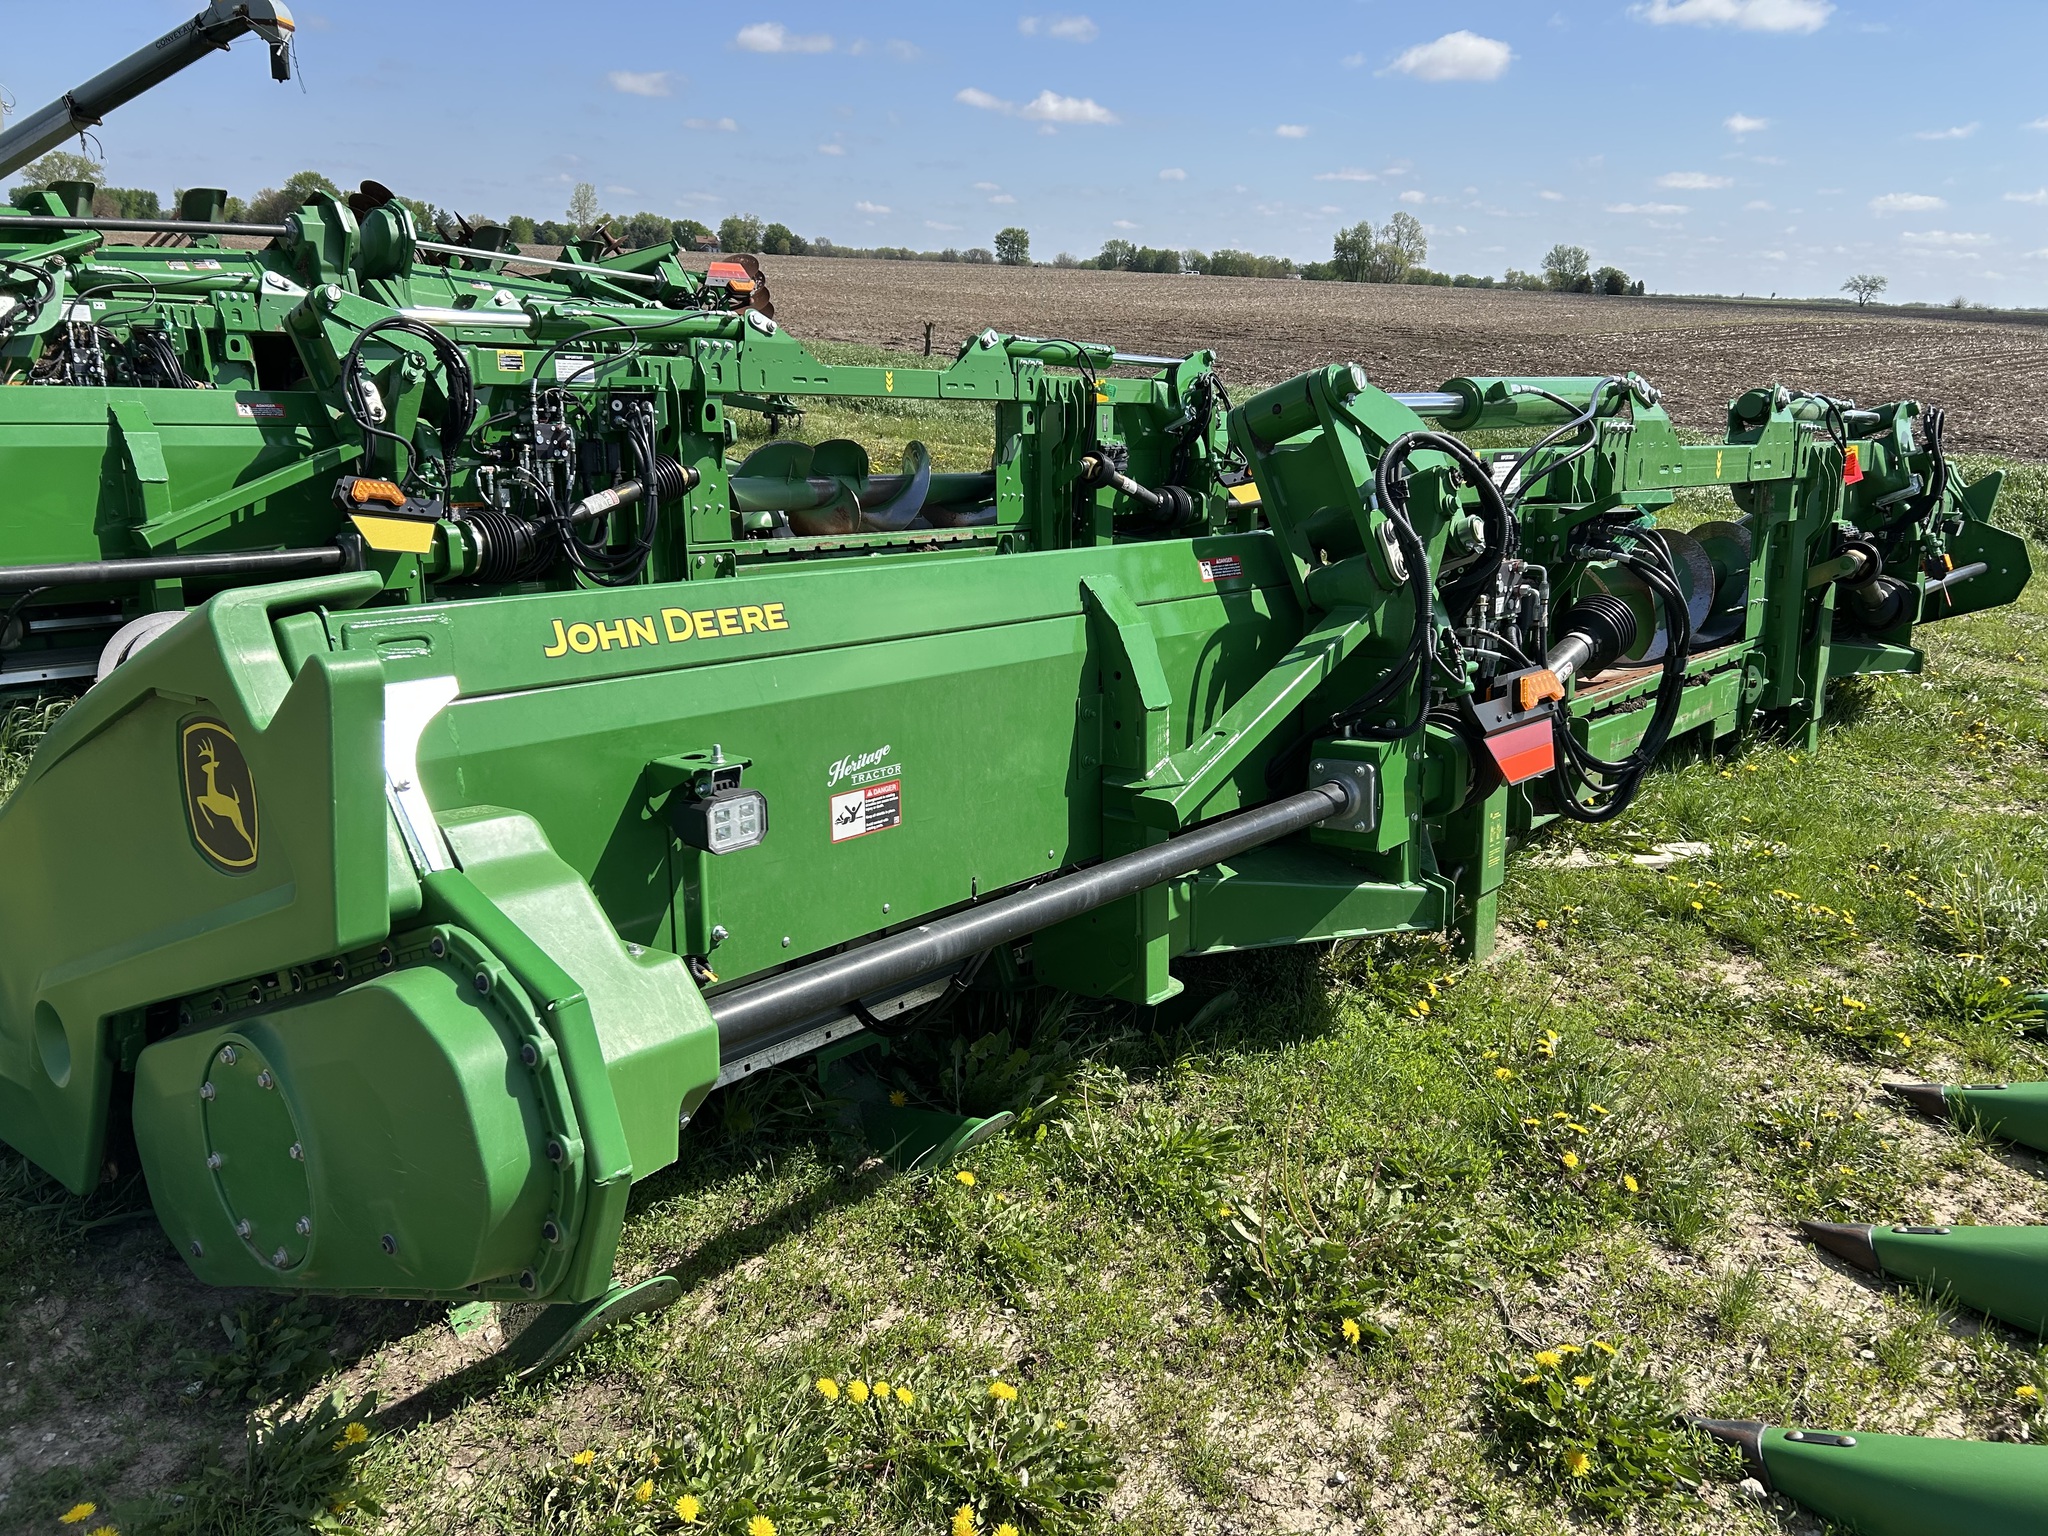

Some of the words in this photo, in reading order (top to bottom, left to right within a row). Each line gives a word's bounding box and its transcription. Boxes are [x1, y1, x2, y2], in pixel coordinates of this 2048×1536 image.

[543, 617, 659, 658] JOHN
[660, 602, 790, 643] DEERE
[827, 744, 892, 788] Heritage
[852, 764, 902, 785] TRACTOR
[873, 784, 897, 795] DANGER
